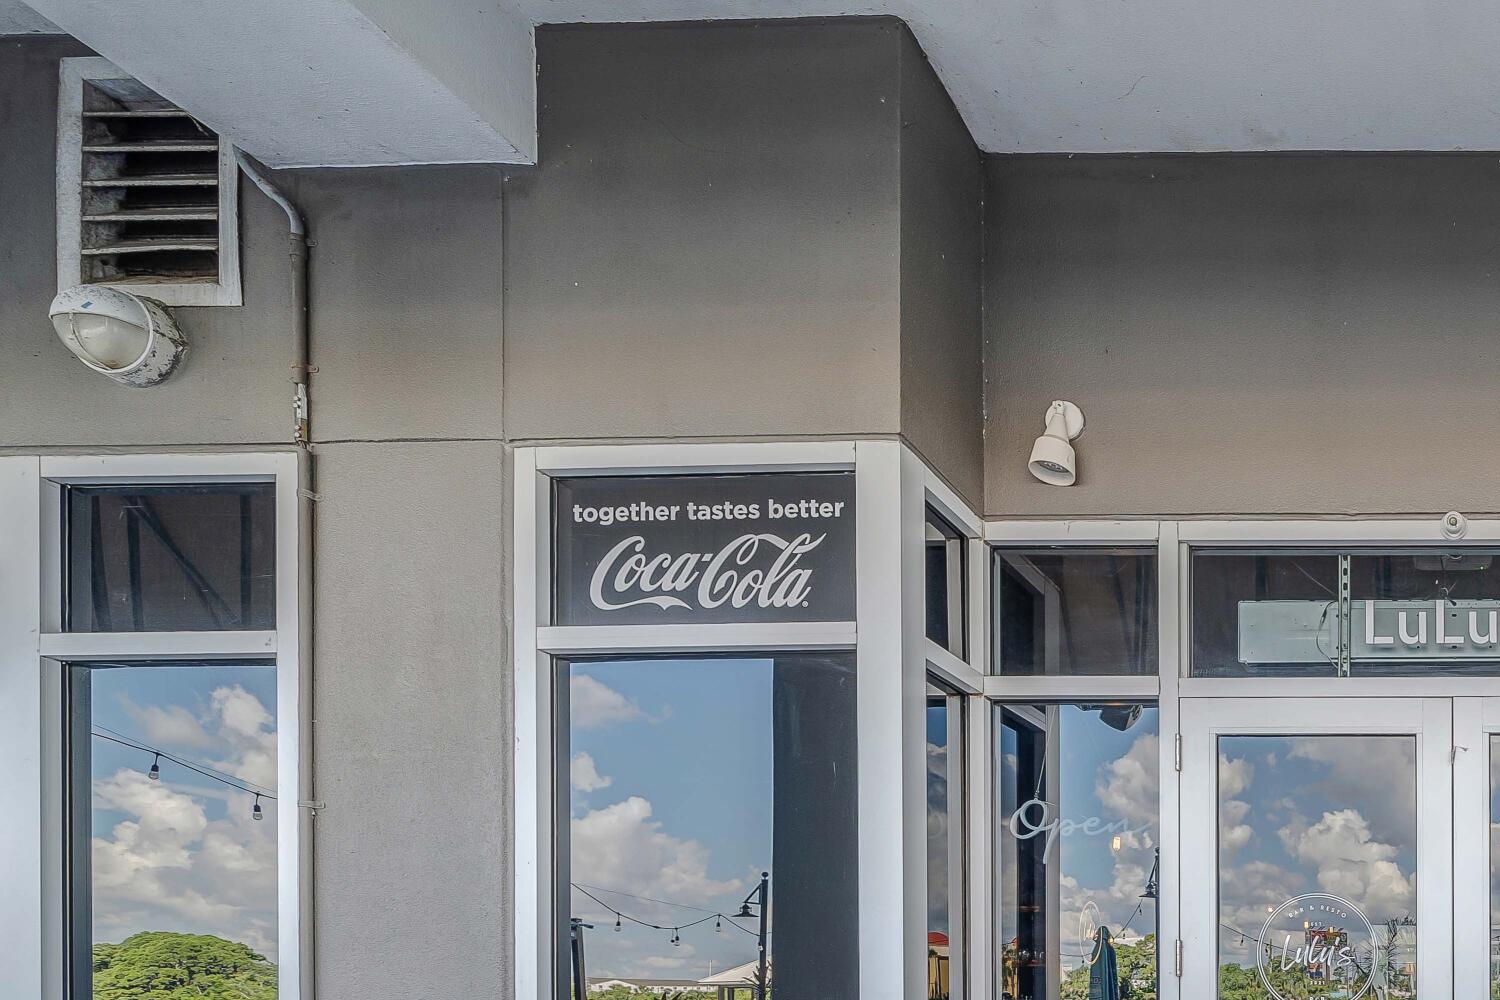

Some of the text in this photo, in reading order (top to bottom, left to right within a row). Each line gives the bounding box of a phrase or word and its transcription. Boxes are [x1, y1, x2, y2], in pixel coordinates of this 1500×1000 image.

[572, 498, 845, 526] together tastes better
[589, 532, 827, 611] Coca-Cola
[1009, 798, 1154, 865] Open
[1320, 904, 1347, 918] RESTO
[1281, 934, 1356, 971] Lulu's
